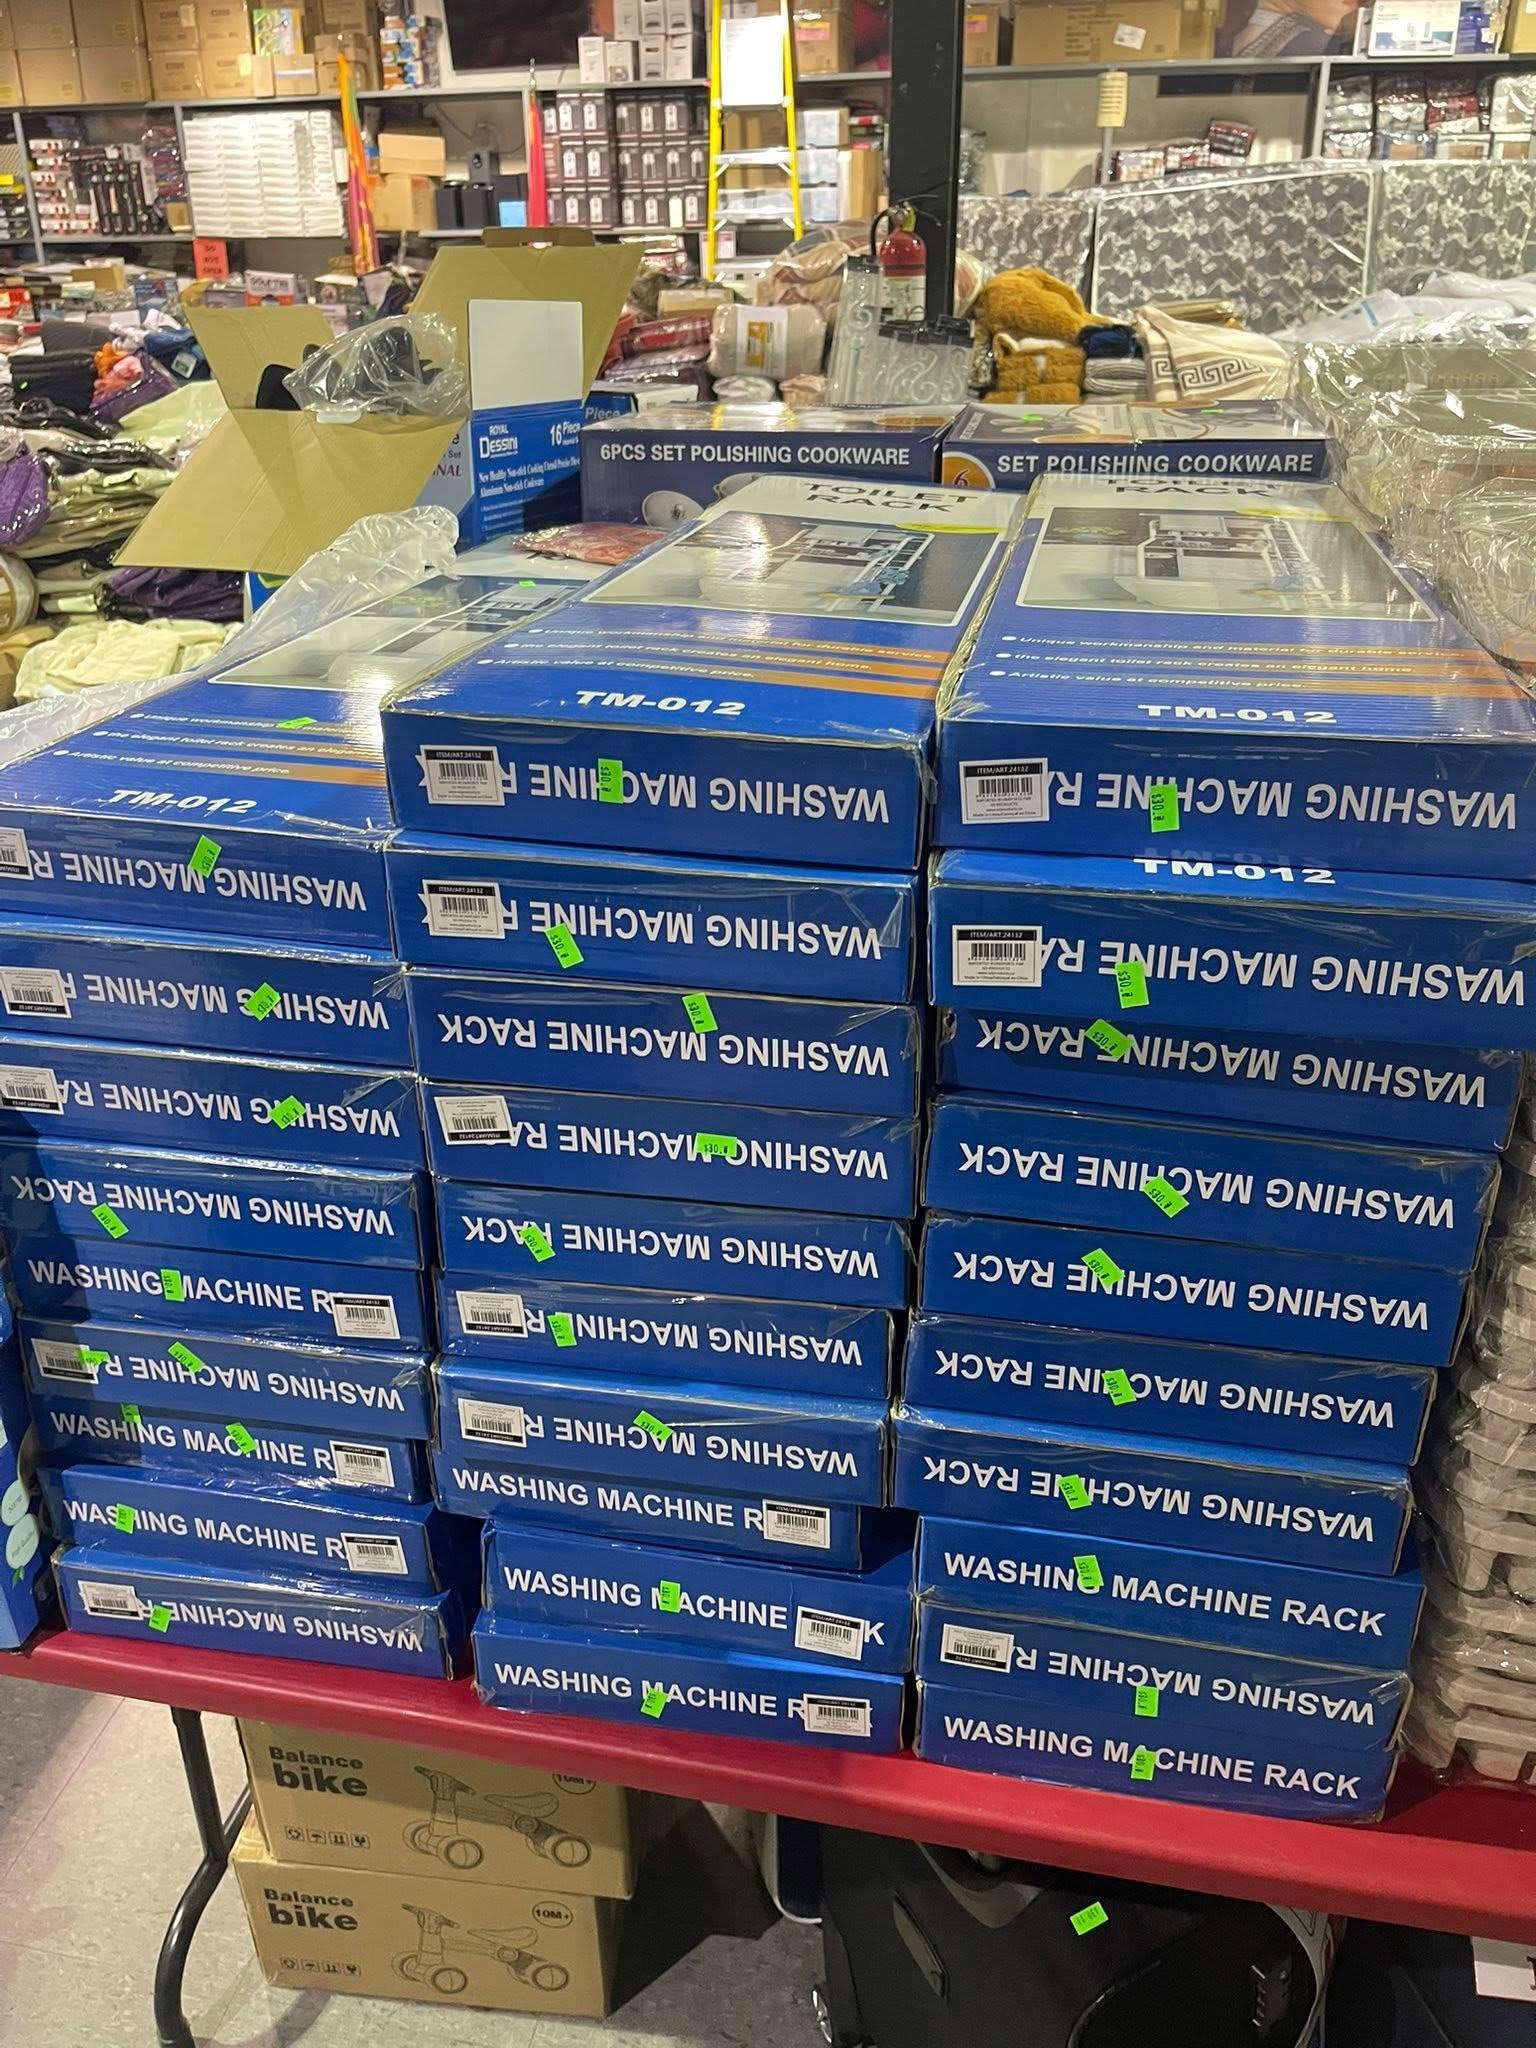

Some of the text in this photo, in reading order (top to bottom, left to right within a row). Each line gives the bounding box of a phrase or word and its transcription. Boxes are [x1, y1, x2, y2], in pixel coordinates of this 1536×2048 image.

[550, 424, 562, 446] 16
[600, 443, 910, 466] 6PCS SET POLISHING COOKWARE
[997, 454, 1314, 473] SET POLISHING COOKWARE
[804, 482, 978, 503] TOILET
[806, 494, 953, 513] RACK
[1116, 486, 1275, 498] RACK
[1019, 636, 1076, 646] Unique
[1080, 639, 1189, 651] workmanship
[1228, 645, 1294, 653] material
[1044, 655, 1106, 664] elegant
[1110, 657, 1152, 665] toilet
[1008, 671, 1071, 680] Artistic
[1075, 674, 1122, 682] value
[1148, 677, 1252, 688] competitive
[575, 690, 747, 716] TM-012
[1137, 703, 1339, 725] TM-012
[107, 788, 258, 815] TM-012
[710, 778, 888, 823] WASHING
[1097, 774, 1291, 816] MACHNE
[1306, 784, 1515, 829] WASHING
[60, 853, 205, 893] MACHINE
[214, 868, 366, 910] WASHING
[1133, 858, 1336, 885] TM-012
[707, 915, 882, 960] WASHING
[1099, 942, 1523, 1005] WASHING MACHINE
[83, 974, 227, 1013] MACHINE
[438, 1015, 889, 1076] WASHING MACHINE RACK
[977, 1020, 1087, 1057] RACK
[1293, 1055, 1484, 1107] WASHING
[100, 1084, 399, 1137] WASHIG MACHINE
[959, 1143, 1063, 1181] RACK
[12, 1177, 394, 1235] WASHING MACHINE RACK
[1266, 1179, 1453, 1228] WASHING
[562, 1224, 878, 1278] WASHING MACHINE
[954, 1252, 1054, 1287] RACK
[29, 1261, 162, 1295] WASHING
[1249, 1285, 1427, 1330] WASHING
[566, 1313, 698, 1349] MACHIN
[709, 1324, 862, 1365] WASHING
[129, 1357, 260, 1391] MACHINE
[936, 1351, 1032, 1385] RACK
[268, 1373, 404, 1411] WASHING
[1220, 1384, 1393, 1428] WASHING
[706, 1436, 857, 1476] WASHING
[452, 1468, 588, 1505] WASHING
[598, 1488, 733, 1526] MACHINE
[924, 1457, 1373, 1541] WASHING RACK
[195, 1518, 318, 1555] MACHINE
[504, 1567, 641, 1606] WASHING
[1112, 1575, 1271, 1618] MACHINE
[1283, 1600, 1385, 1636] RACK
[293, 1617, 422, 1652] WASHING
[495, 1663, 631, 1697] WASHING
[1048, 1652, 1200, 1696] MACHINE
[1213, 1679, 1373, 1725] WASHING
[268, 1745, 363, 1770] Balance
[945, 1716, 1092, 1757] WASHING
[1265, 1764, 1360, 1798] RACK
[273, 1762, 368, 1797] bike
[264, 1888, 354, 1908] Balance
[535, 1908, 570, 1921] 10M+
[268, 1903, 359, 1931] bike
